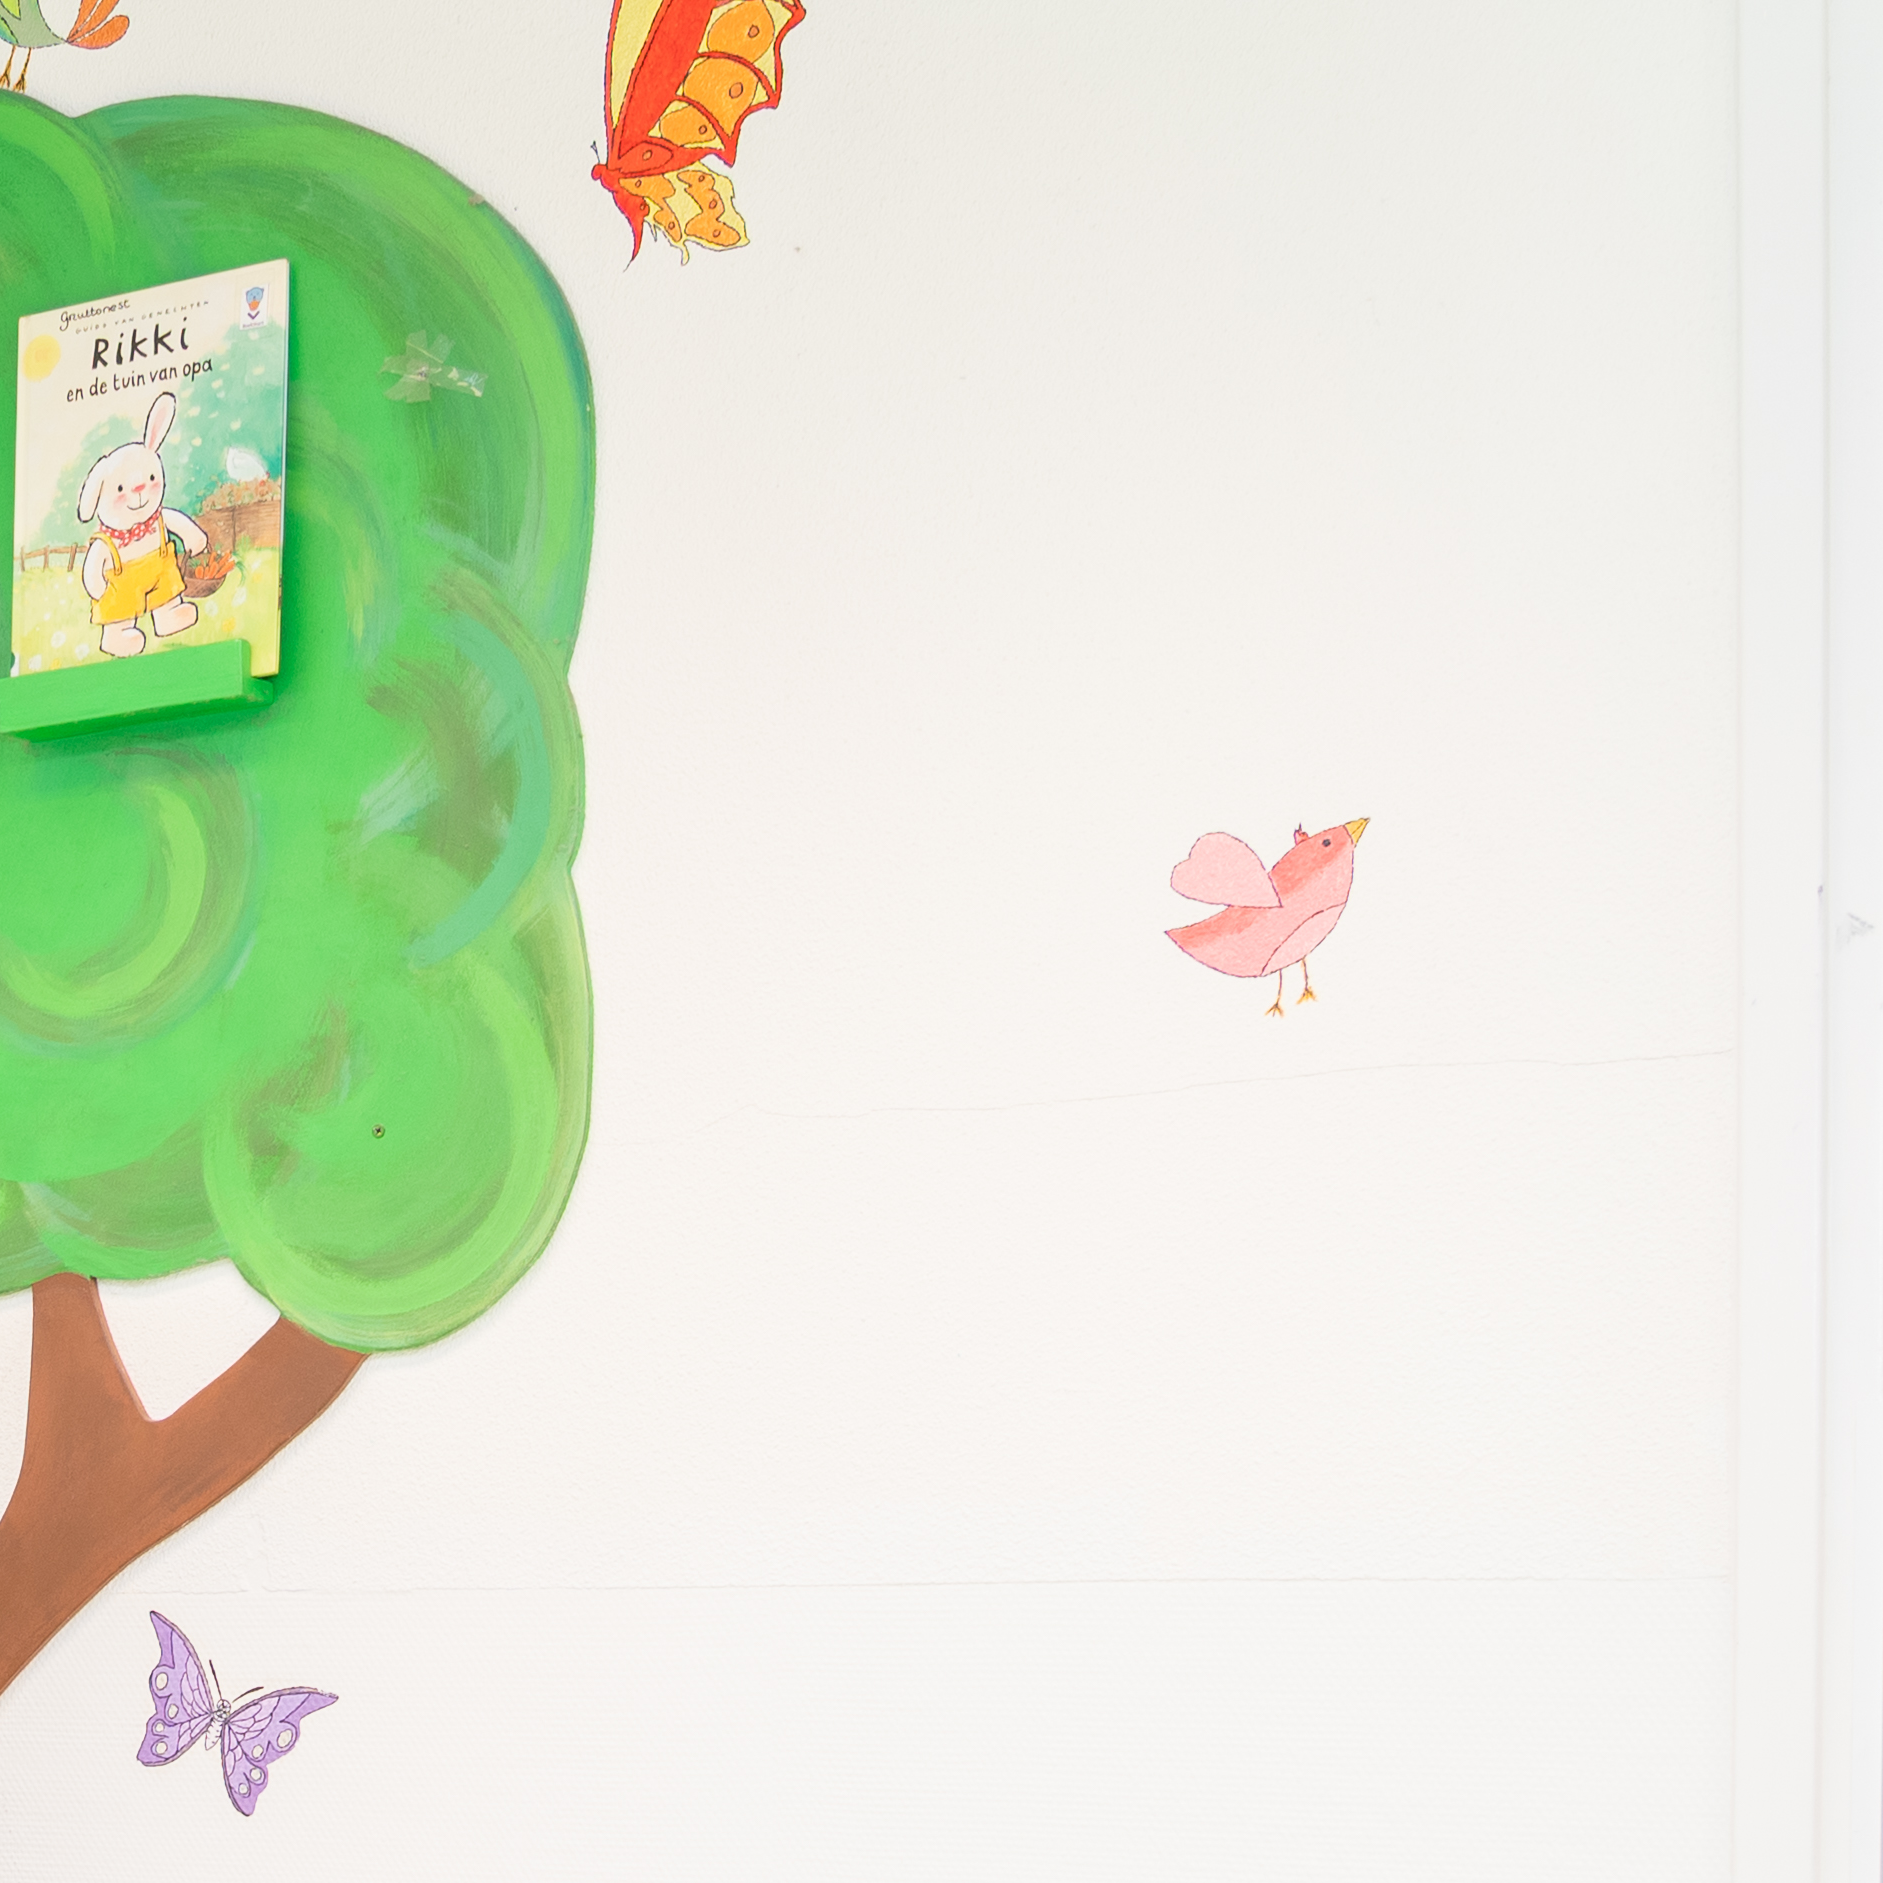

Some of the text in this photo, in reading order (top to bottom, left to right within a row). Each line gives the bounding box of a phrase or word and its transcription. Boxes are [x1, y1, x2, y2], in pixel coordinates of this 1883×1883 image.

[75, 323, 107, 334] GUIDO
[115, 317, 134, 326] VAN
[92, 316, 189, 370] Rikki
[66, 358, 213, 403] en de tuin van opa
